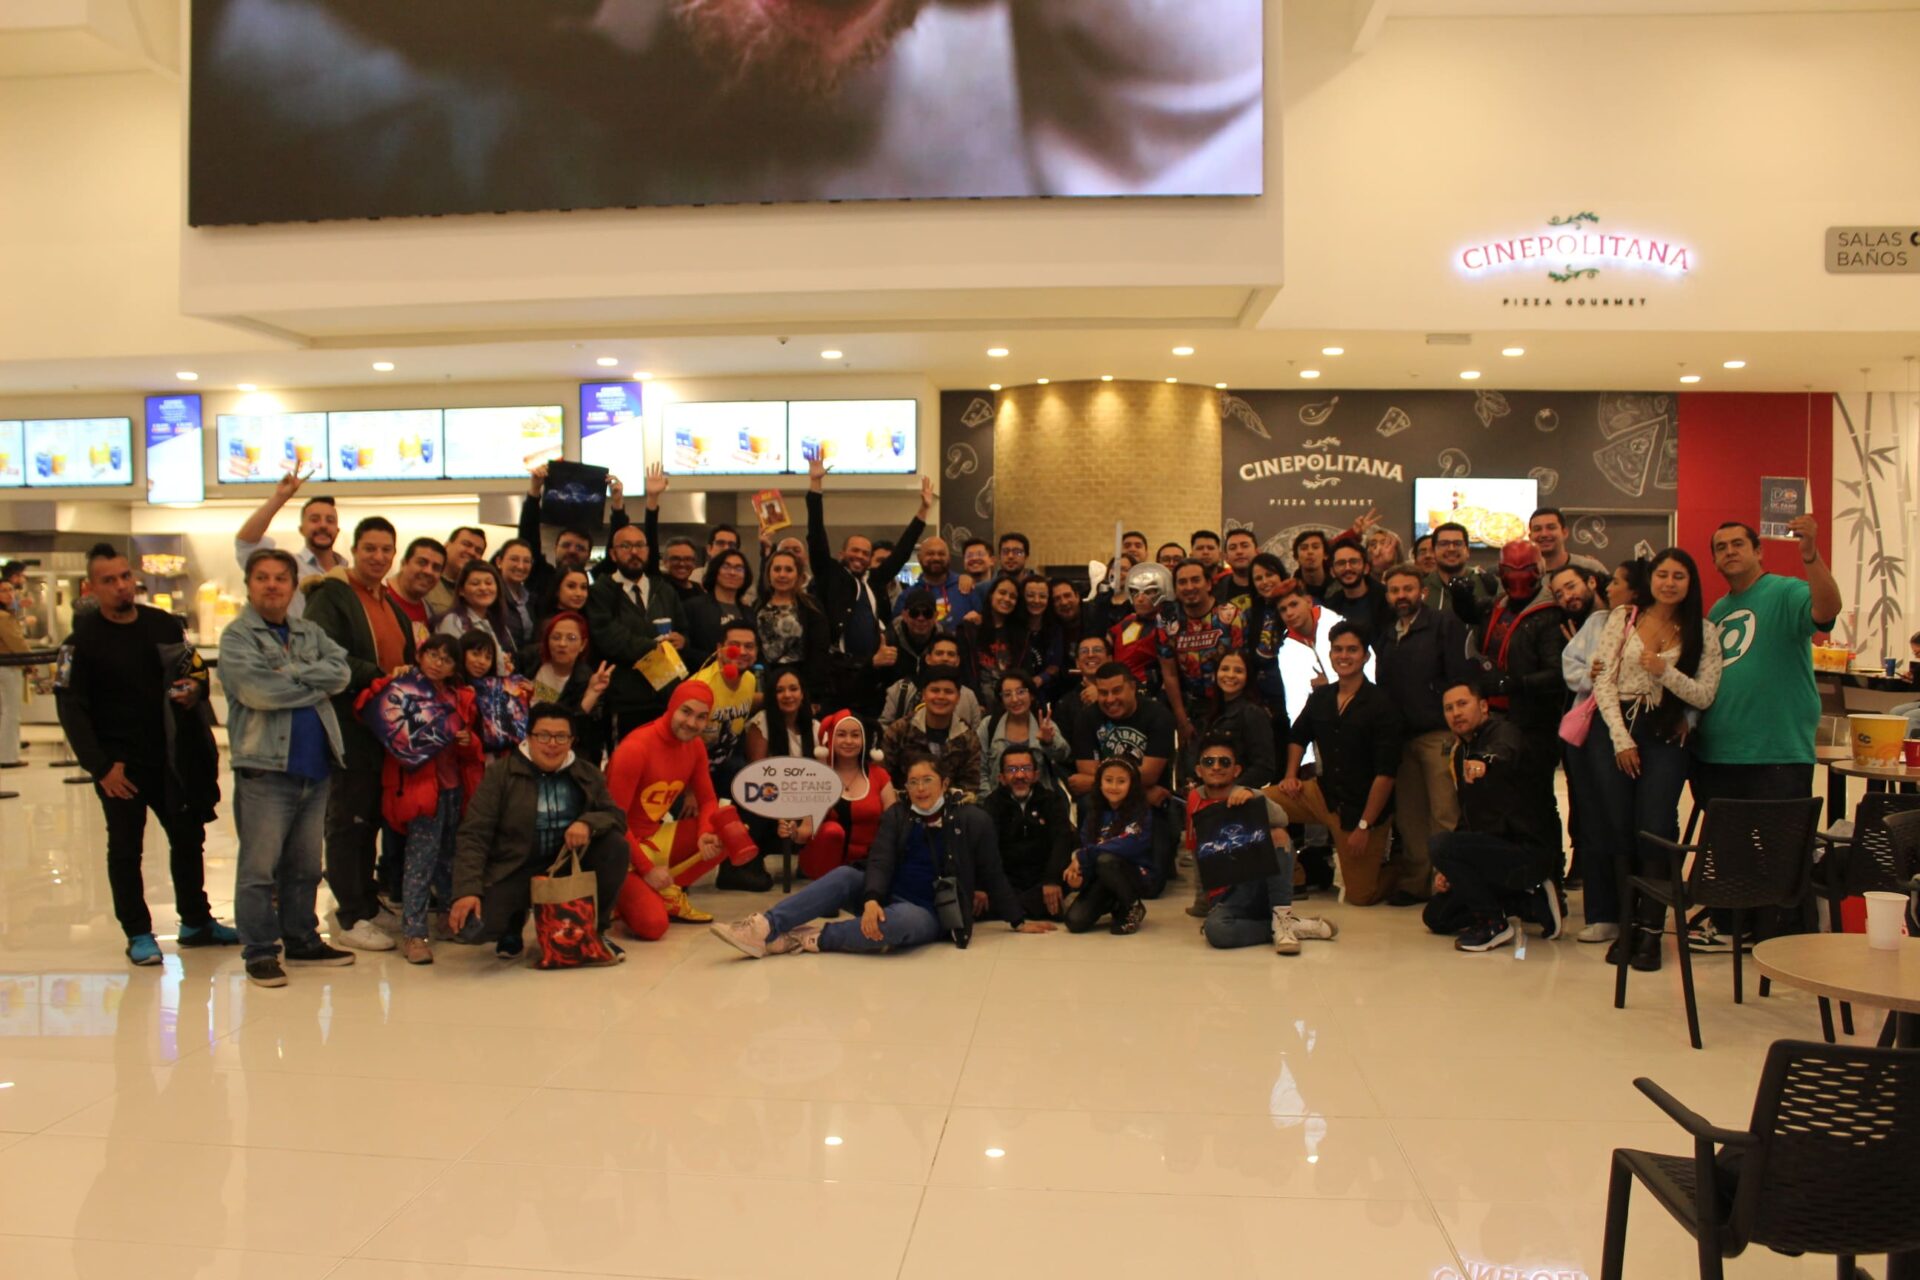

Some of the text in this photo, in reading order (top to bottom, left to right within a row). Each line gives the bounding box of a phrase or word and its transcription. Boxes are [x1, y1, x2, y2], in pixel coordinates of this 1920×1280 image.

[1838, 231, 1902, 247] SALAS
[1462, 234, 1689, 270] CINEPOLITANA
[1837, 248, 1908, 266] BAÑOS
[1503, 298, 1646, 306] PIZZA GOURMET
[1239, 454, 1403, 482] CINEPOLITANA
[762, 766, 777, 777] YO
[781, 781, 832, 791] DC FANS
